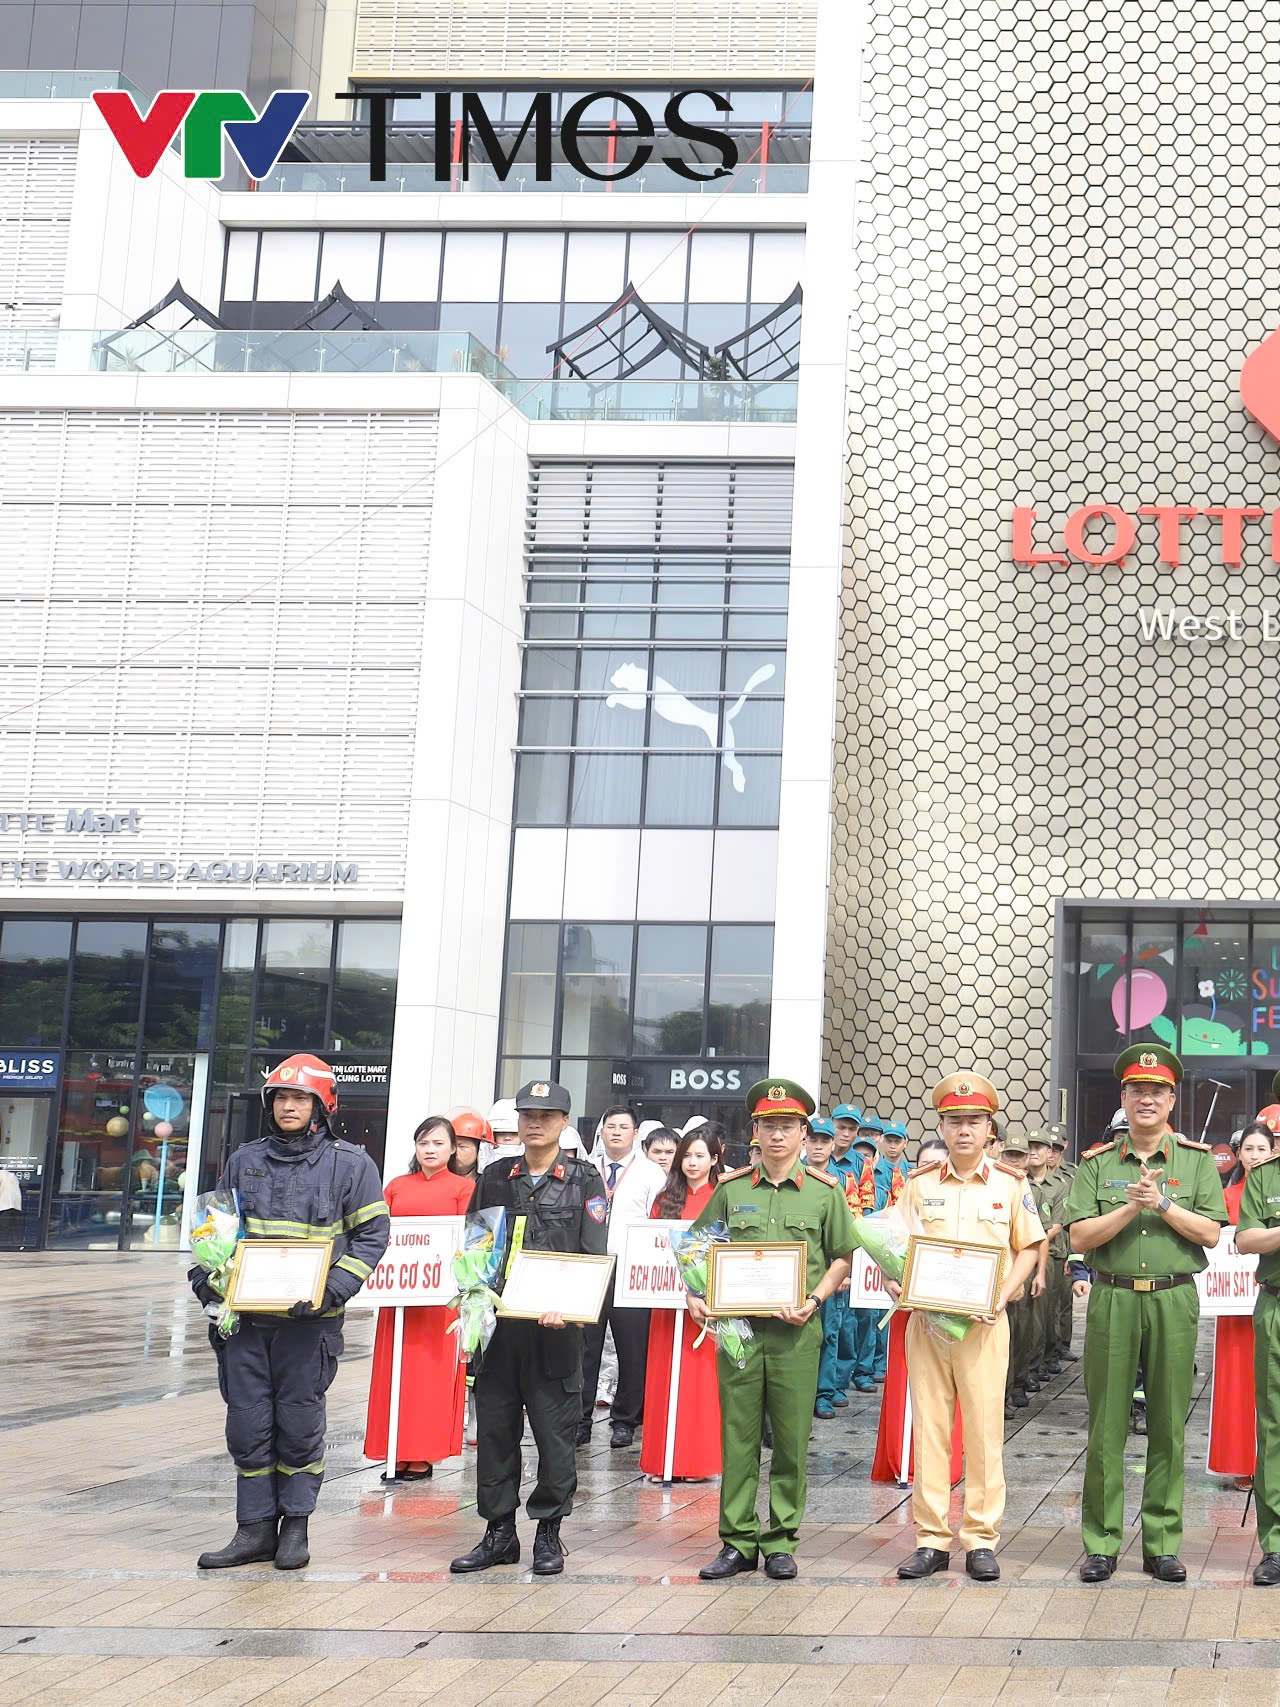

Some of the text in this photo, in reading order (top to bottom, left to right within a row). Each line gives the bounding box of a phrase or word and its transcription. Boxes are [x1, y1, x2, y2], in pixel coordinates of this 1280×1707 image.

[1138, 607, 1243, 642] West
[65, 808, 142, 833] Mart
[57, 860, 177, 882] WORLD
[183, 860, 359, 882] AQUARIUM
[336, 1074, 387, 1082] CUNG LOTTE
[344, 1065, 366, 1073] LOTTE
[367, 1065, 387, 1073] MART
[612, 1072, 627, 1086] BOSS
[670, 1069, 741, 1090] BOSS
[366, 1263, 394, 1290] CCC
[629, 1264, 649, 1291] BCH
